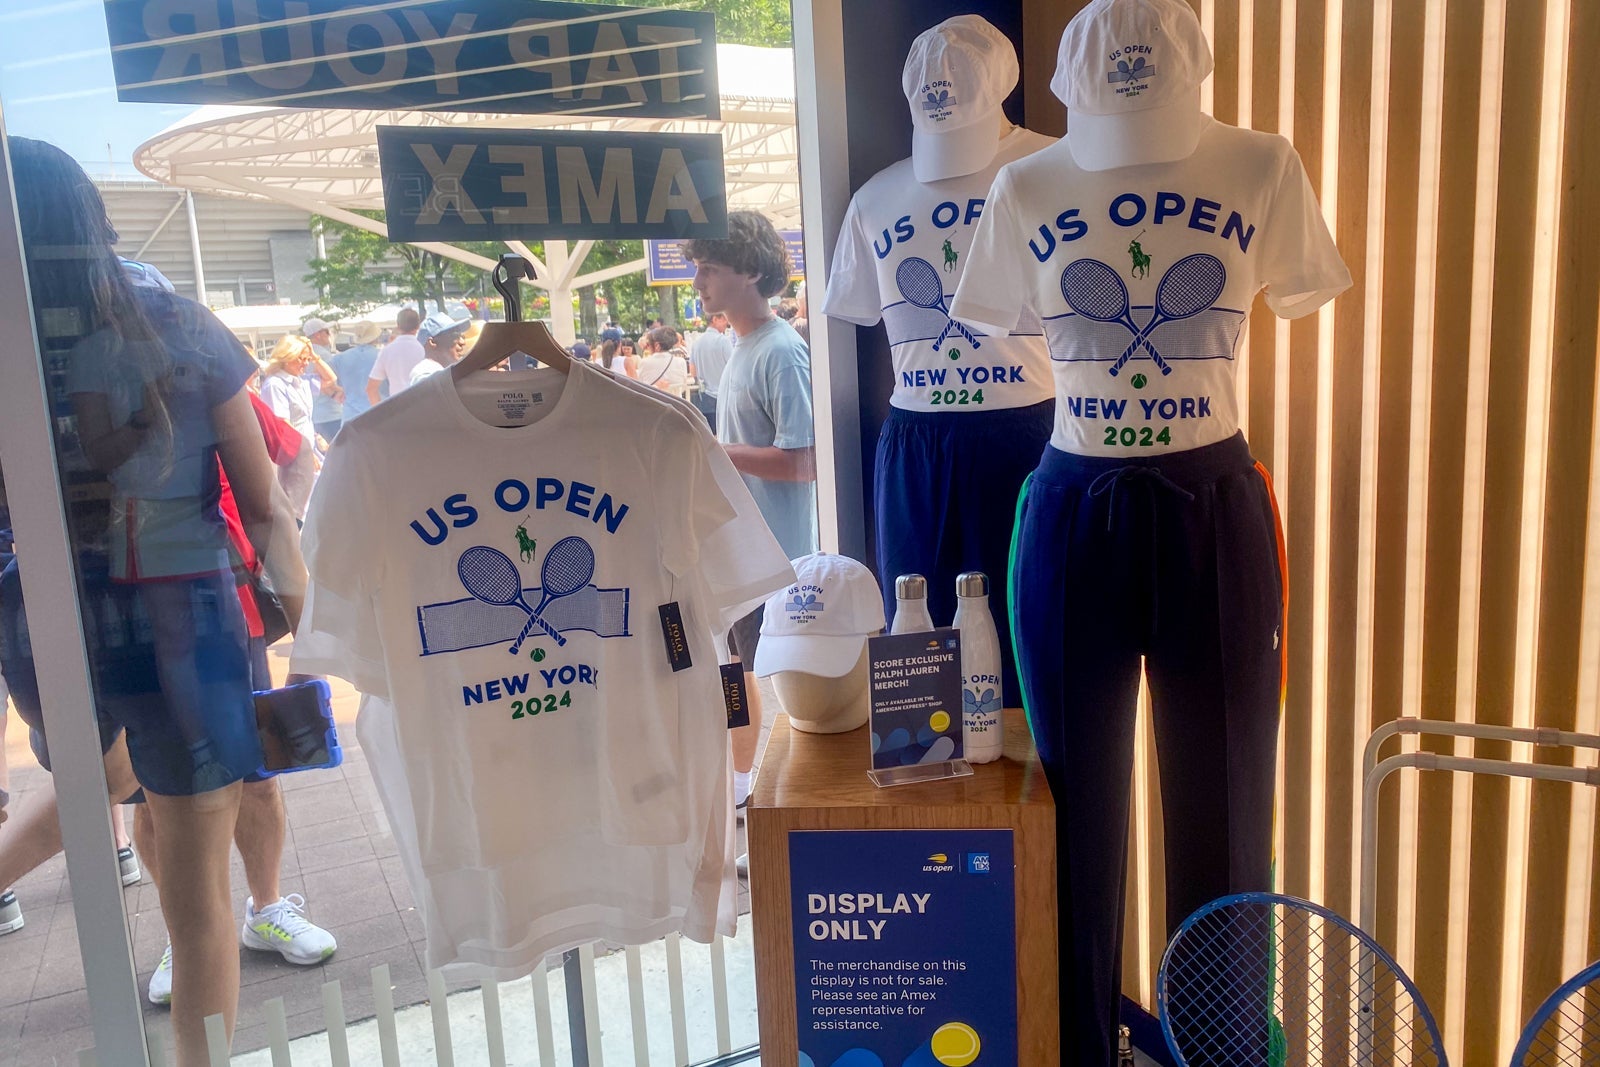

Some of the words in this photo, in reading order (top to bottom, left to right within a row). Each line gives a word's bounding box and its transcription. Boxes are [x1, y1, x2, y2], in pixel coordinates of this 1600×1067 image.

[1109, 50, 1121, 61] US
[1124, 45, 1152, 54] OPEN
[922, 85, 930, 93] US
[874, 215, 915, 259] US
[932, 199, 985, 228] OP
[1029, 209, 1088, 262] US
[1109, 192, 1255, 254] OPEN
[902, 368, 947, 387] NEW
[956, 366, 1025, 384] YORK
[930, 389, 984, 404] 2024
[1068, 397, 1127, 420] NEW
[1139, 396, 1211, 420] YORK
[1104, 426, 1171, 446] 2024
[410, 494, 478, 546] US
[494, 478, 629, 534] OPEN
[801, 585, 823, 594] OPEN
[672, 623, 683, 652] POLO
[874, 659, 903, 669] SCORE
[906, 653, 954, 666] EXCLUSIVE
[874, 669, 903, 680] RALPH
[905, 665, 940, 676] LAUREN
[971, 674, 999, 685] OPEN
[462, 673, 530, 706] NEW
[874, 679, 909, 690] MERCH!
[511, 690, 572, 720] 2024
[730, 683, 741, 711] POLO
[932, 865, 953, 873] open
[808, 893, 931, 914] DISPLAY
[809, 920, 887, 940] ONLY
[810, 959, 834, 970] The
[837, 959, 920, 970] merchandise
[923, 961, 939, 970] on
[942, 959, 967, 970] this
[811, 975, 855, 987] display
[859, 975, 869, 985] is
[872, 976, 894, 985] not
[897, 975, 915, 985] for
[918, 975, 948, 985] sale.
[811, 989, 853, 1000] Please
[856, 991, 878, 1000] see
[881, 991, 897, 1000] an
[900, 990, 937, 1000] Amex
[812, 1004, 904, 1016] representative
[907, 1004, 926, 1015] for
[812, 1019, 883, 1030] assistance.
